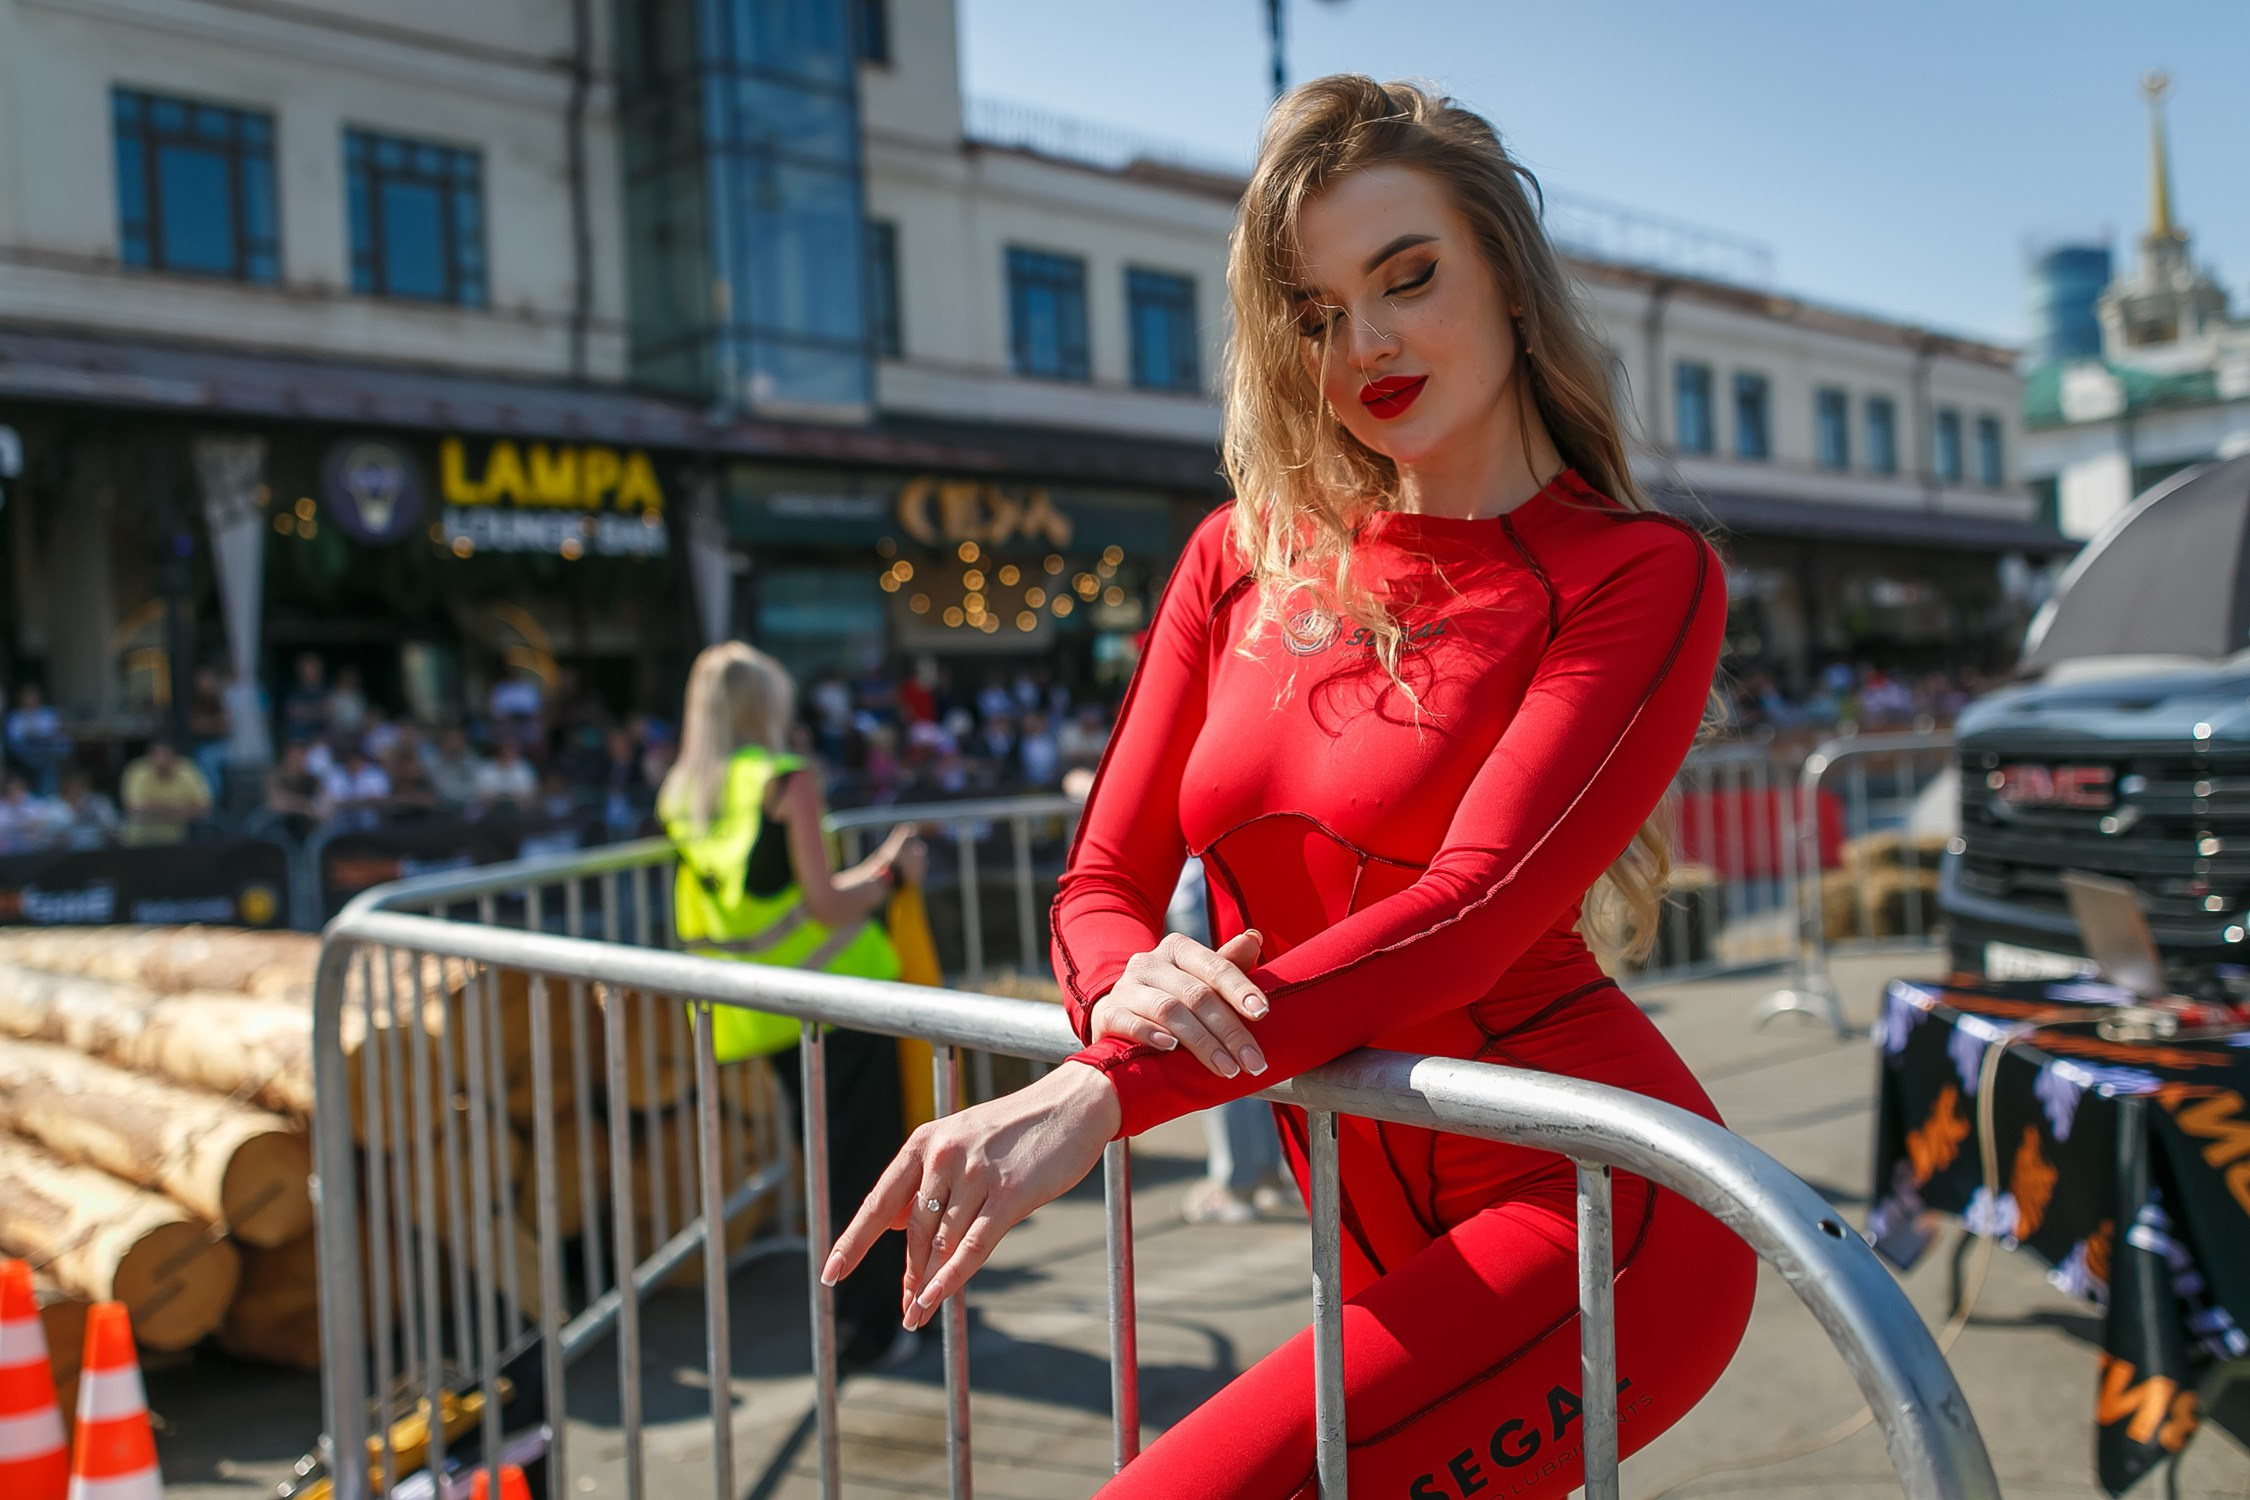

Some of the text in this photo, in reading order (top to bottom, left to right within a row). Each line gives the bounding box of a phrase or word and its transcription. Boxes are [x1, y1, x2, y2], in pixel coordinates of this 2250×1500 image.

[441, 436, 664, 512] LAMPA
[442, 505, 669, 558] LOUNGE BAR
